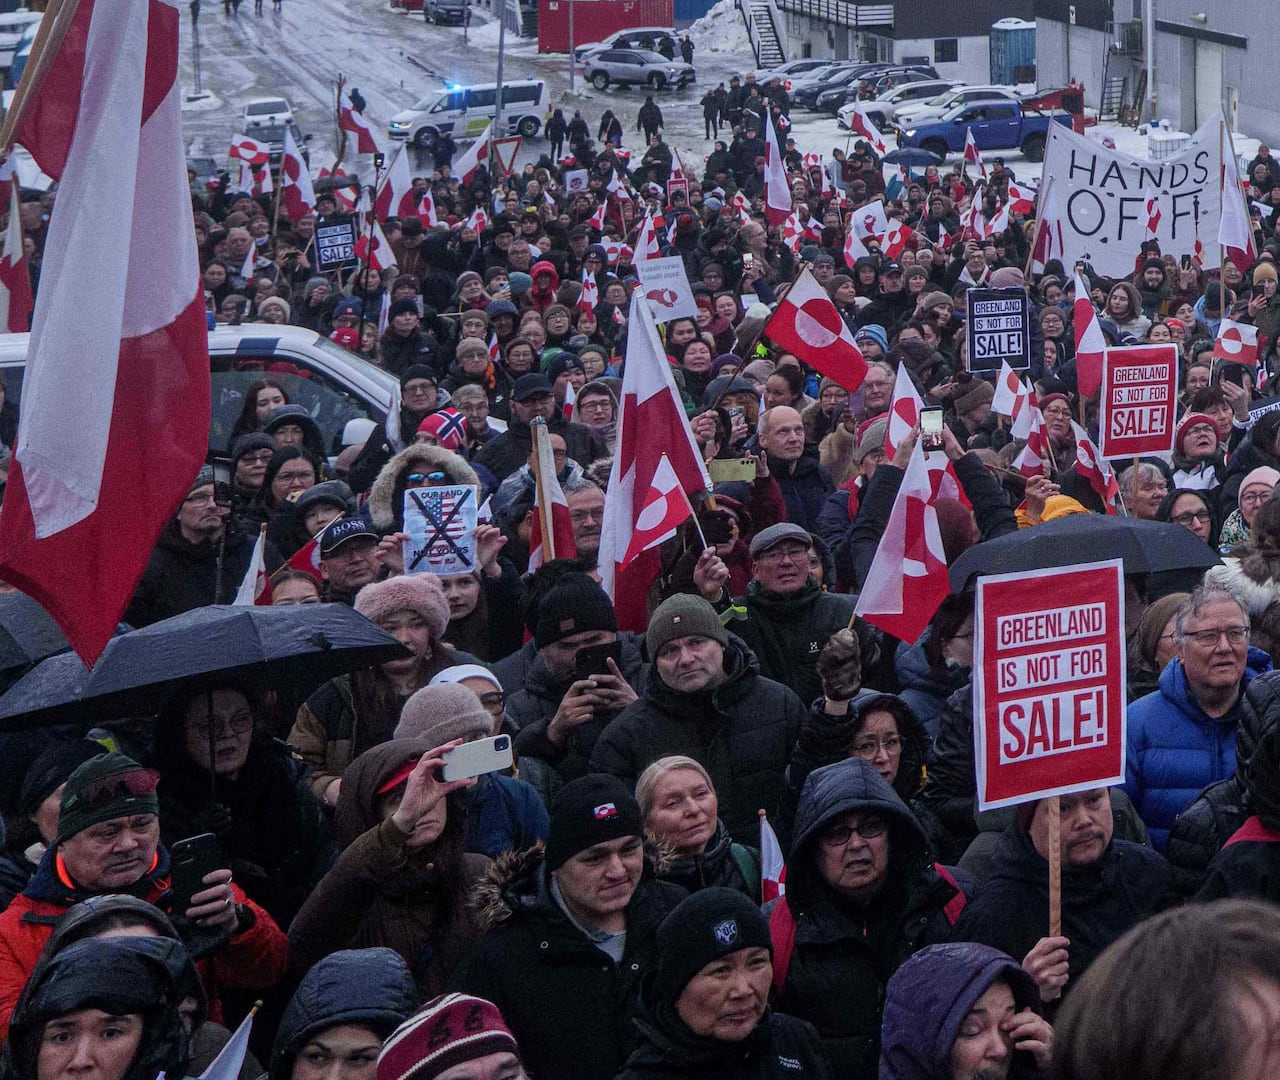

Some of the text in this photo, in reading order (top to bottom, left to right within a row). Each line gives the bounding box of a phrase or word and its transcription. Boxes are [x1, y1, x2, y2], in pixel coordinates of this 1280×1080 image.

[1069, 149, 1209, 190] HANDS
[1067, 188, 1203, 240] OFF
[975, 300, 1019, 314] GREENLAND
[976, 316, 1021, 329] IS NOT FOR
[977, 333, 1021, 356] SALE!
[1115, 366, 1168, 382] GREENLAND
[1114, 386, 1166, 403] IS NOT FOR
[1113, 408, 1165, 437] SALE!
[332, 520, 366, 537] BOSS
[1001, 607, 1102, 646] GREENLAND
[1001, 648, 1103, 688] IS NOT FOR
[1003, 690, 1105, 760] SALE!
